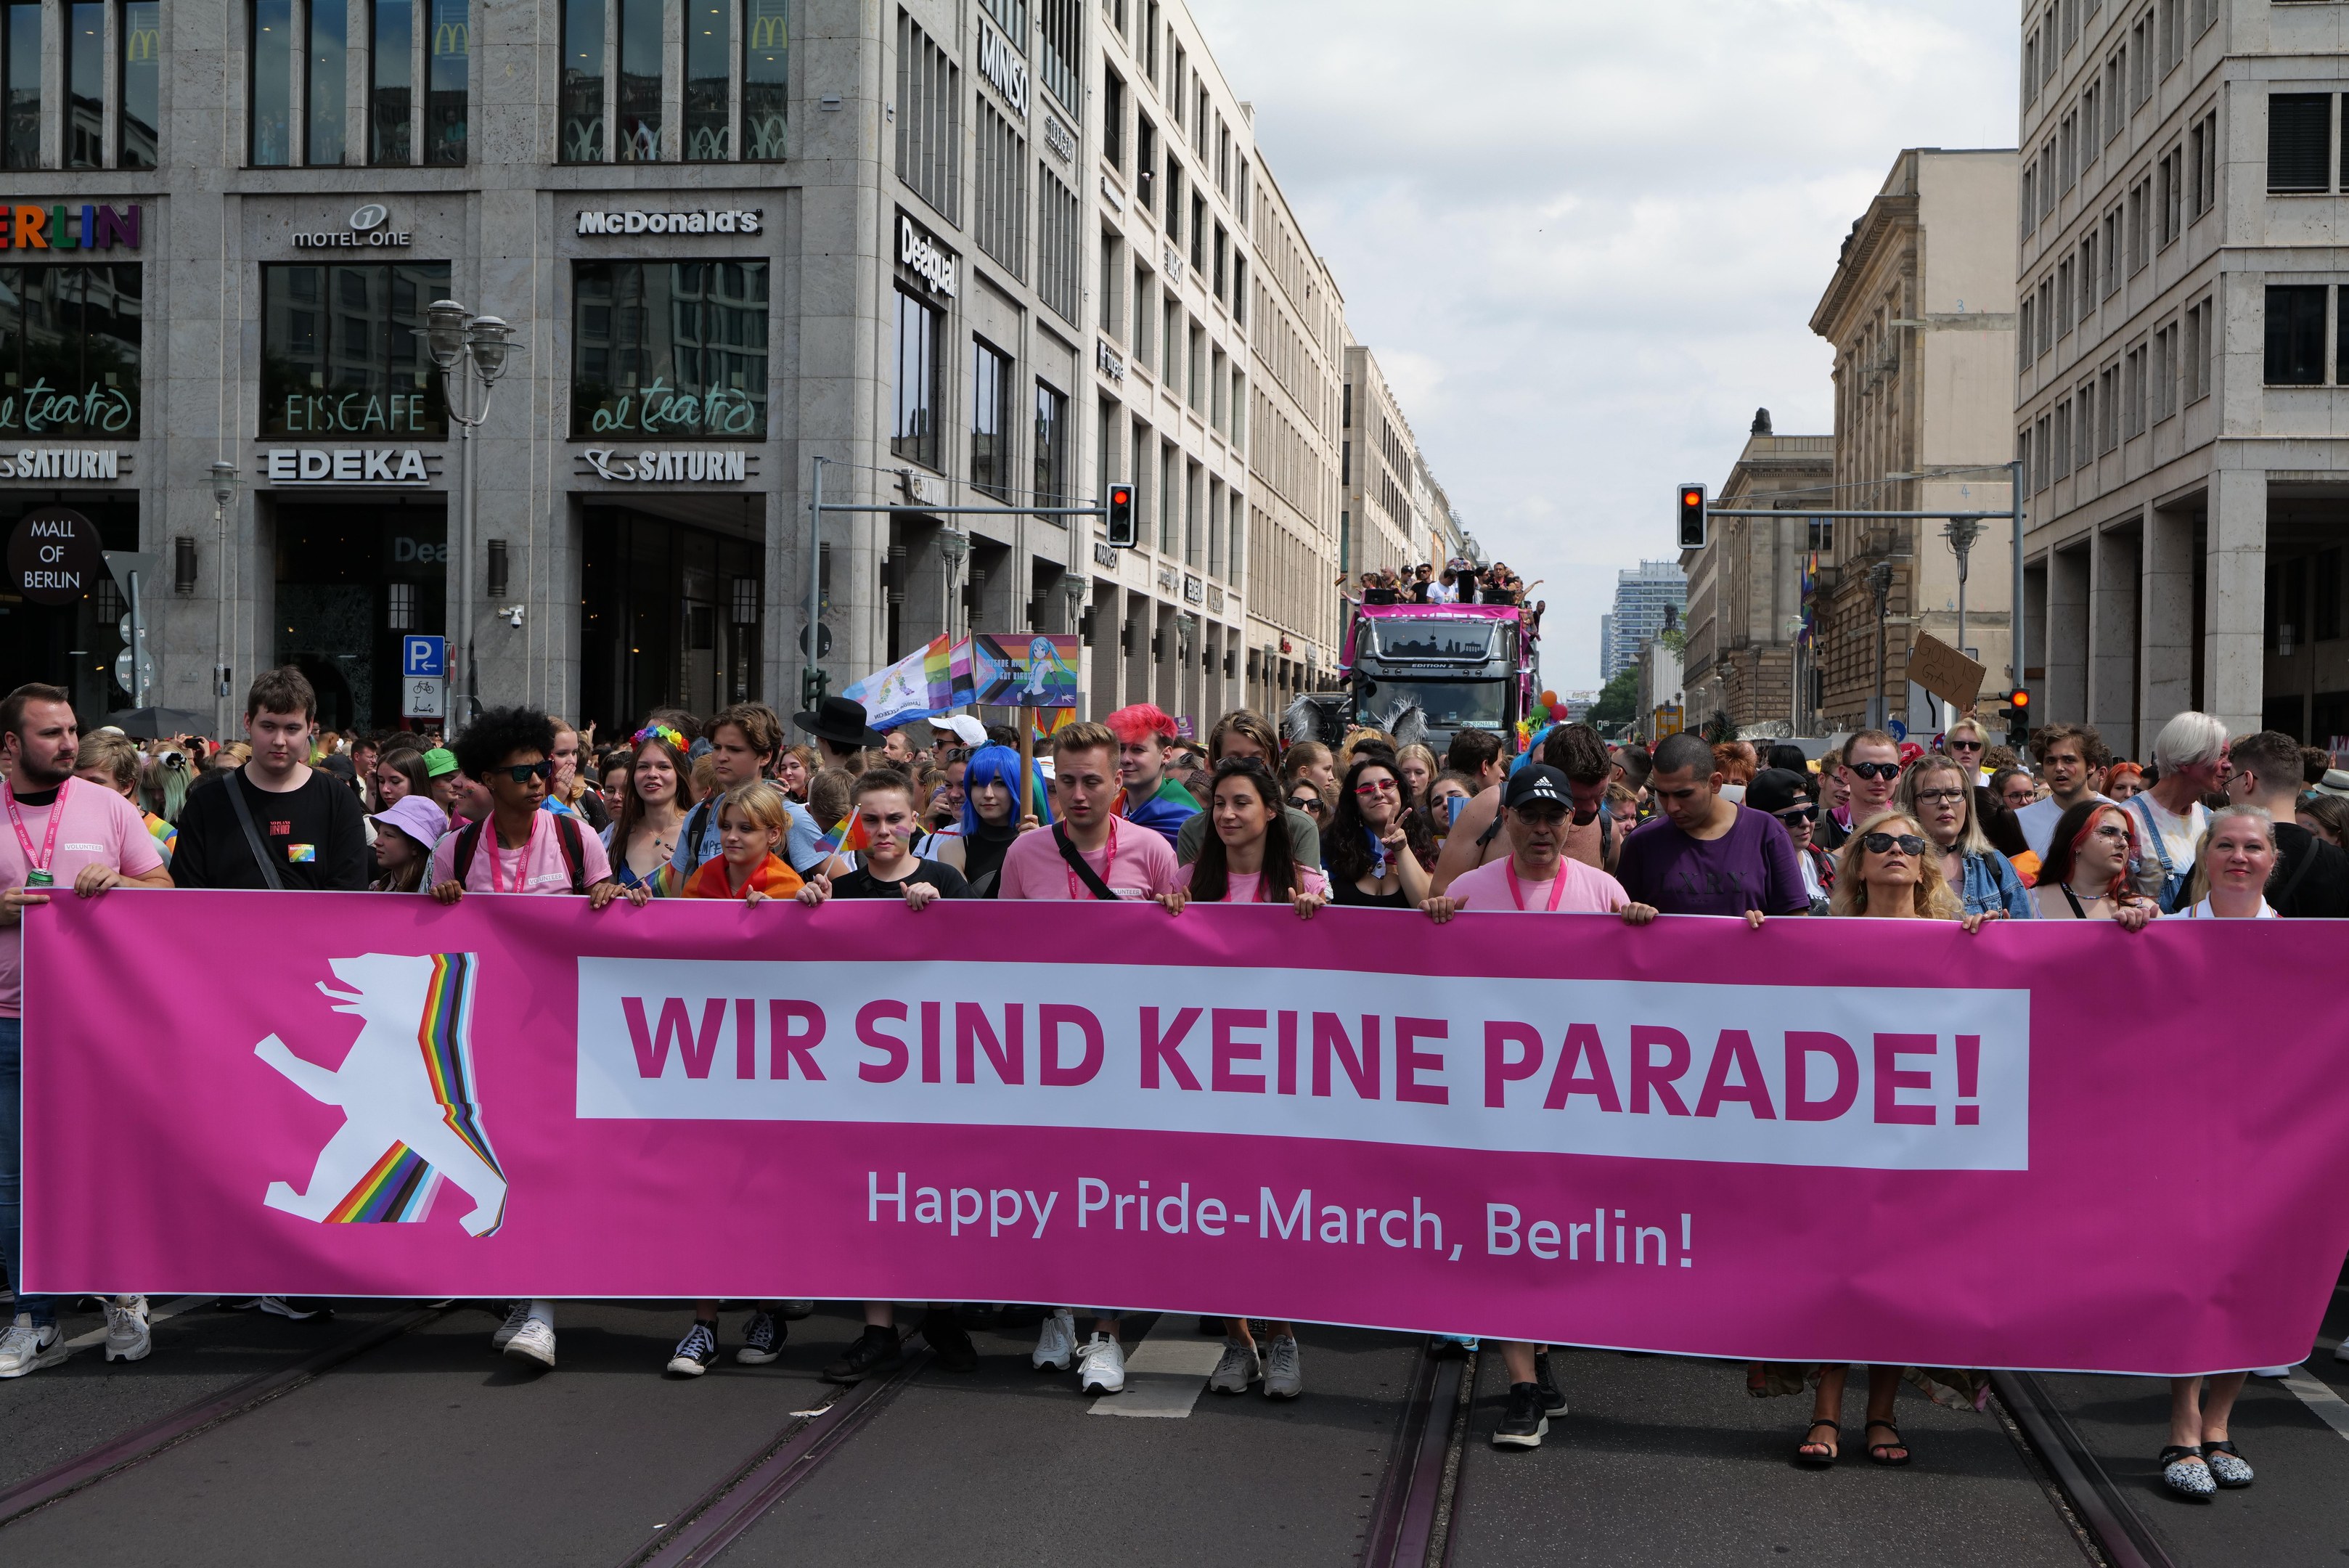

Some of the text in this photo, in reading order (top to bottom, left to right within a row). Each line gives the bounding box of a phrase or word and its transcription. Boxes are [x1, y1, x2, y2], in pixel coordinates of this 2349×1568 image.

[981, 20, 1029, 118] MINISO
[0, 205, 142, 248] RLIN
[579, 210, 758, 234] McDonald's
[293, 232, 409, 246] MOTEL ONE
[287, 393, 425, 430] EISCAFE
[592, 396, 635, 432] al
[17, 449, 118, 478] SATURN
[269, 449, 428, 480] EDEKA
[639, 450, 745, 481] SATURN
[31, 520, 75, 536] MALL
[40, 546, 64, 563] OF
[25, 571, 80, 588] BERLIN
[411, 641, 432, 671] P
[1918, 637, 1978, 683] GOD IS
[1922, 663, 1963, 697] GAY
[530, 873, 562, 884] VOLUNTEER
[621, 997, 1980, 1127] WIR SIND KEINE PARADE!
[869, 1172, 1691, 1268] Happy Pride-March, Berlin!
